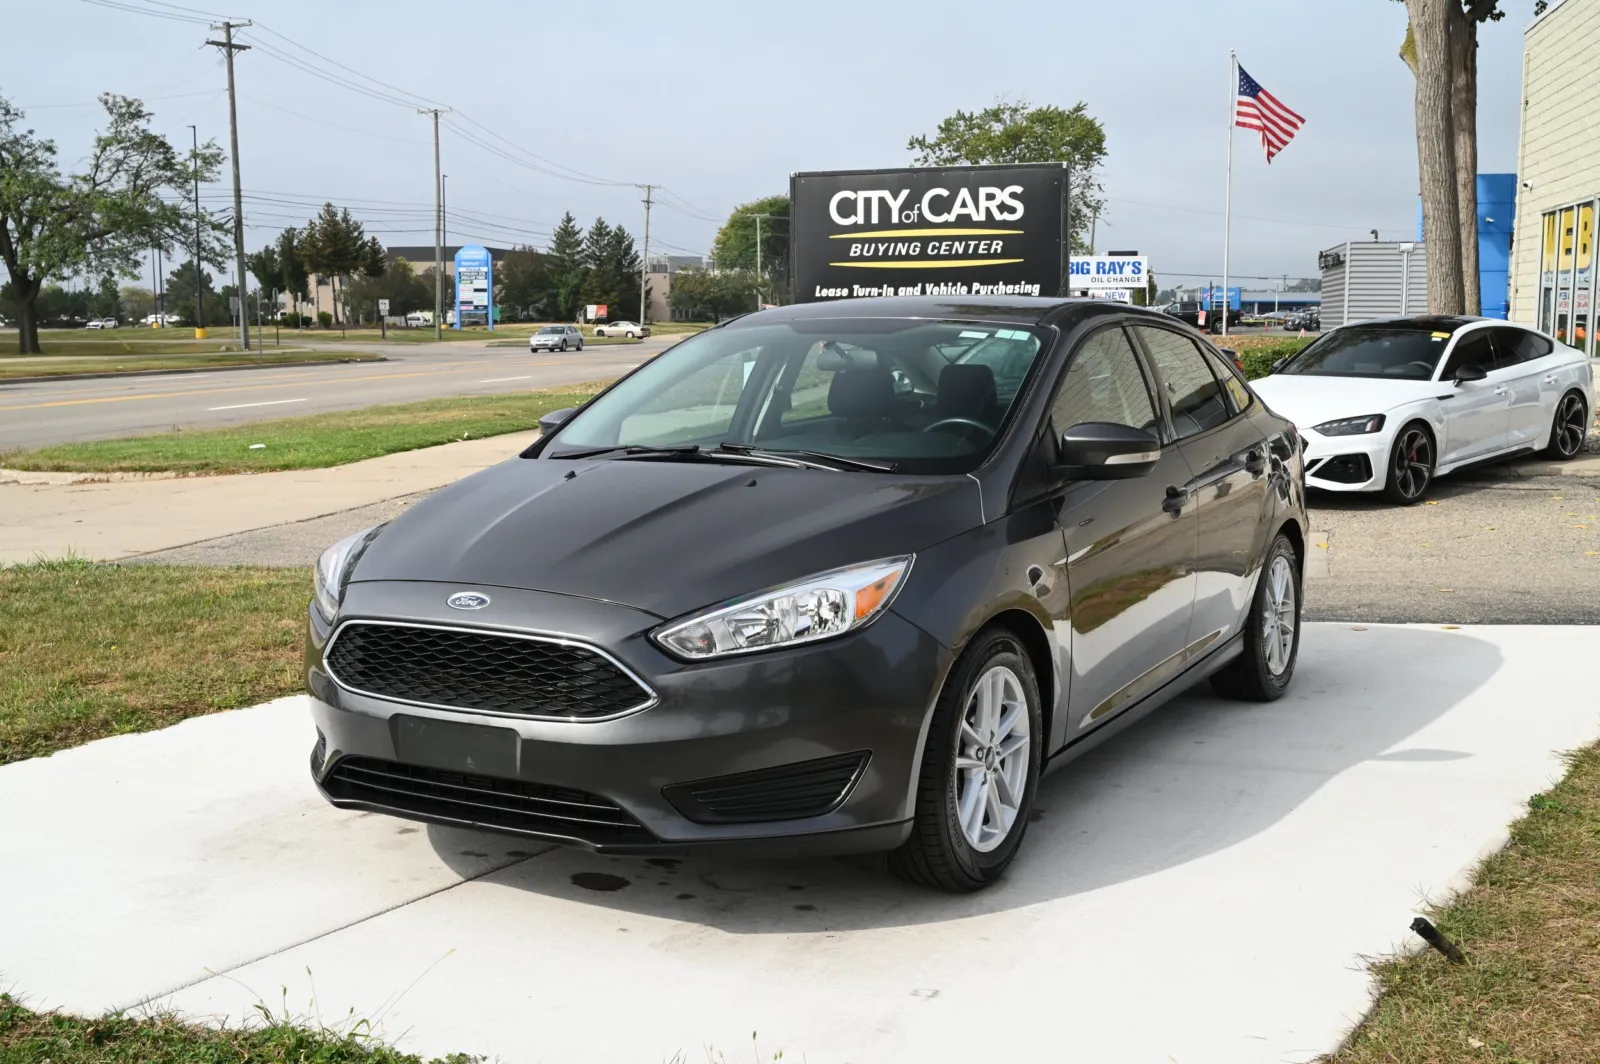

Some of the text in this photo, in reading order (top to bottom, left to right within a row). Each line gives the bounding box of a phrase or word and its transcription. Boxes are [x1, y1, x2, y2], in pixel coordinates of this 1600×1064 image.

[829, 185, 1025, 226] CITY of CARS
[849, 240, 1004, 257] BUYING CENTER
[1068, 260, 1142, 275] BIG RAY'S
[815, 280, 1041, 297] Lease Turn-In and Vehicle Purchasing
[1104, 291, 1127, 300] NEW
[455, 595, 481, 606] Ford
